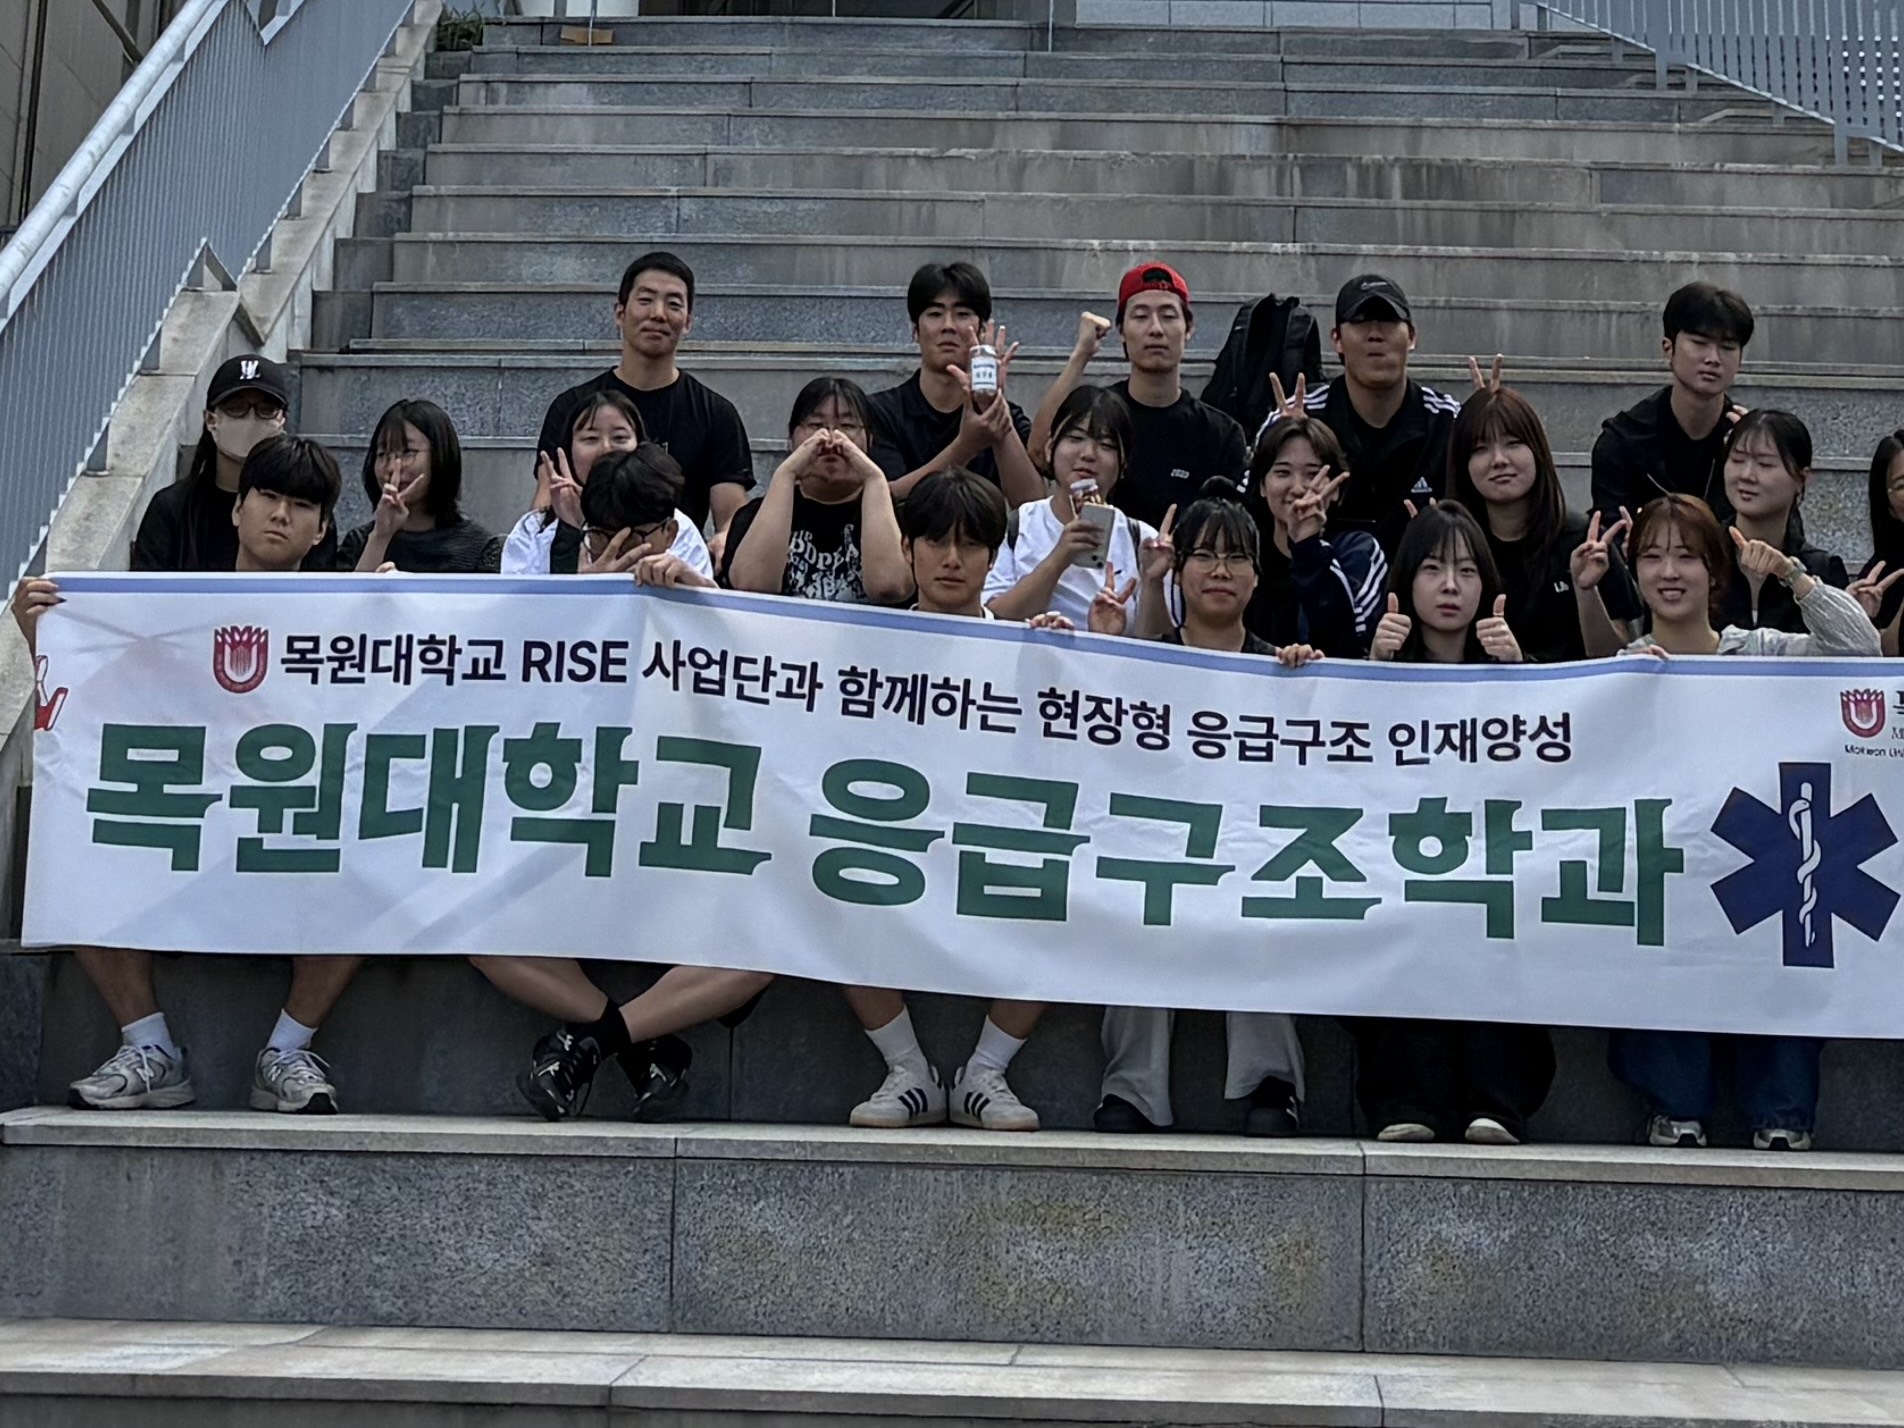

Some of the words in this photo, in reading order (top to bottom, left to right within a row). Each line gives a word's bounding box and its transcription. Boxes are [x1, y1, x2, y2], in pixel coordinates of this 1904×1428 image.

[280, 633, 507, 686] 목원대학교
[521, 640, 629, 684] RISE
[642, 638, 824, 712] 사업단과
[838, 664, 1023, 735] 함께하는
[1038, 687, 1172, 752] 현장형
[1187, 709, 1373, 766] 응급구조
[1388, 711, 1574, 767] 인재양성
[86, 721, 773, 879] 목원대학교
[808, 756, 1686, 947] 응급구조학과
